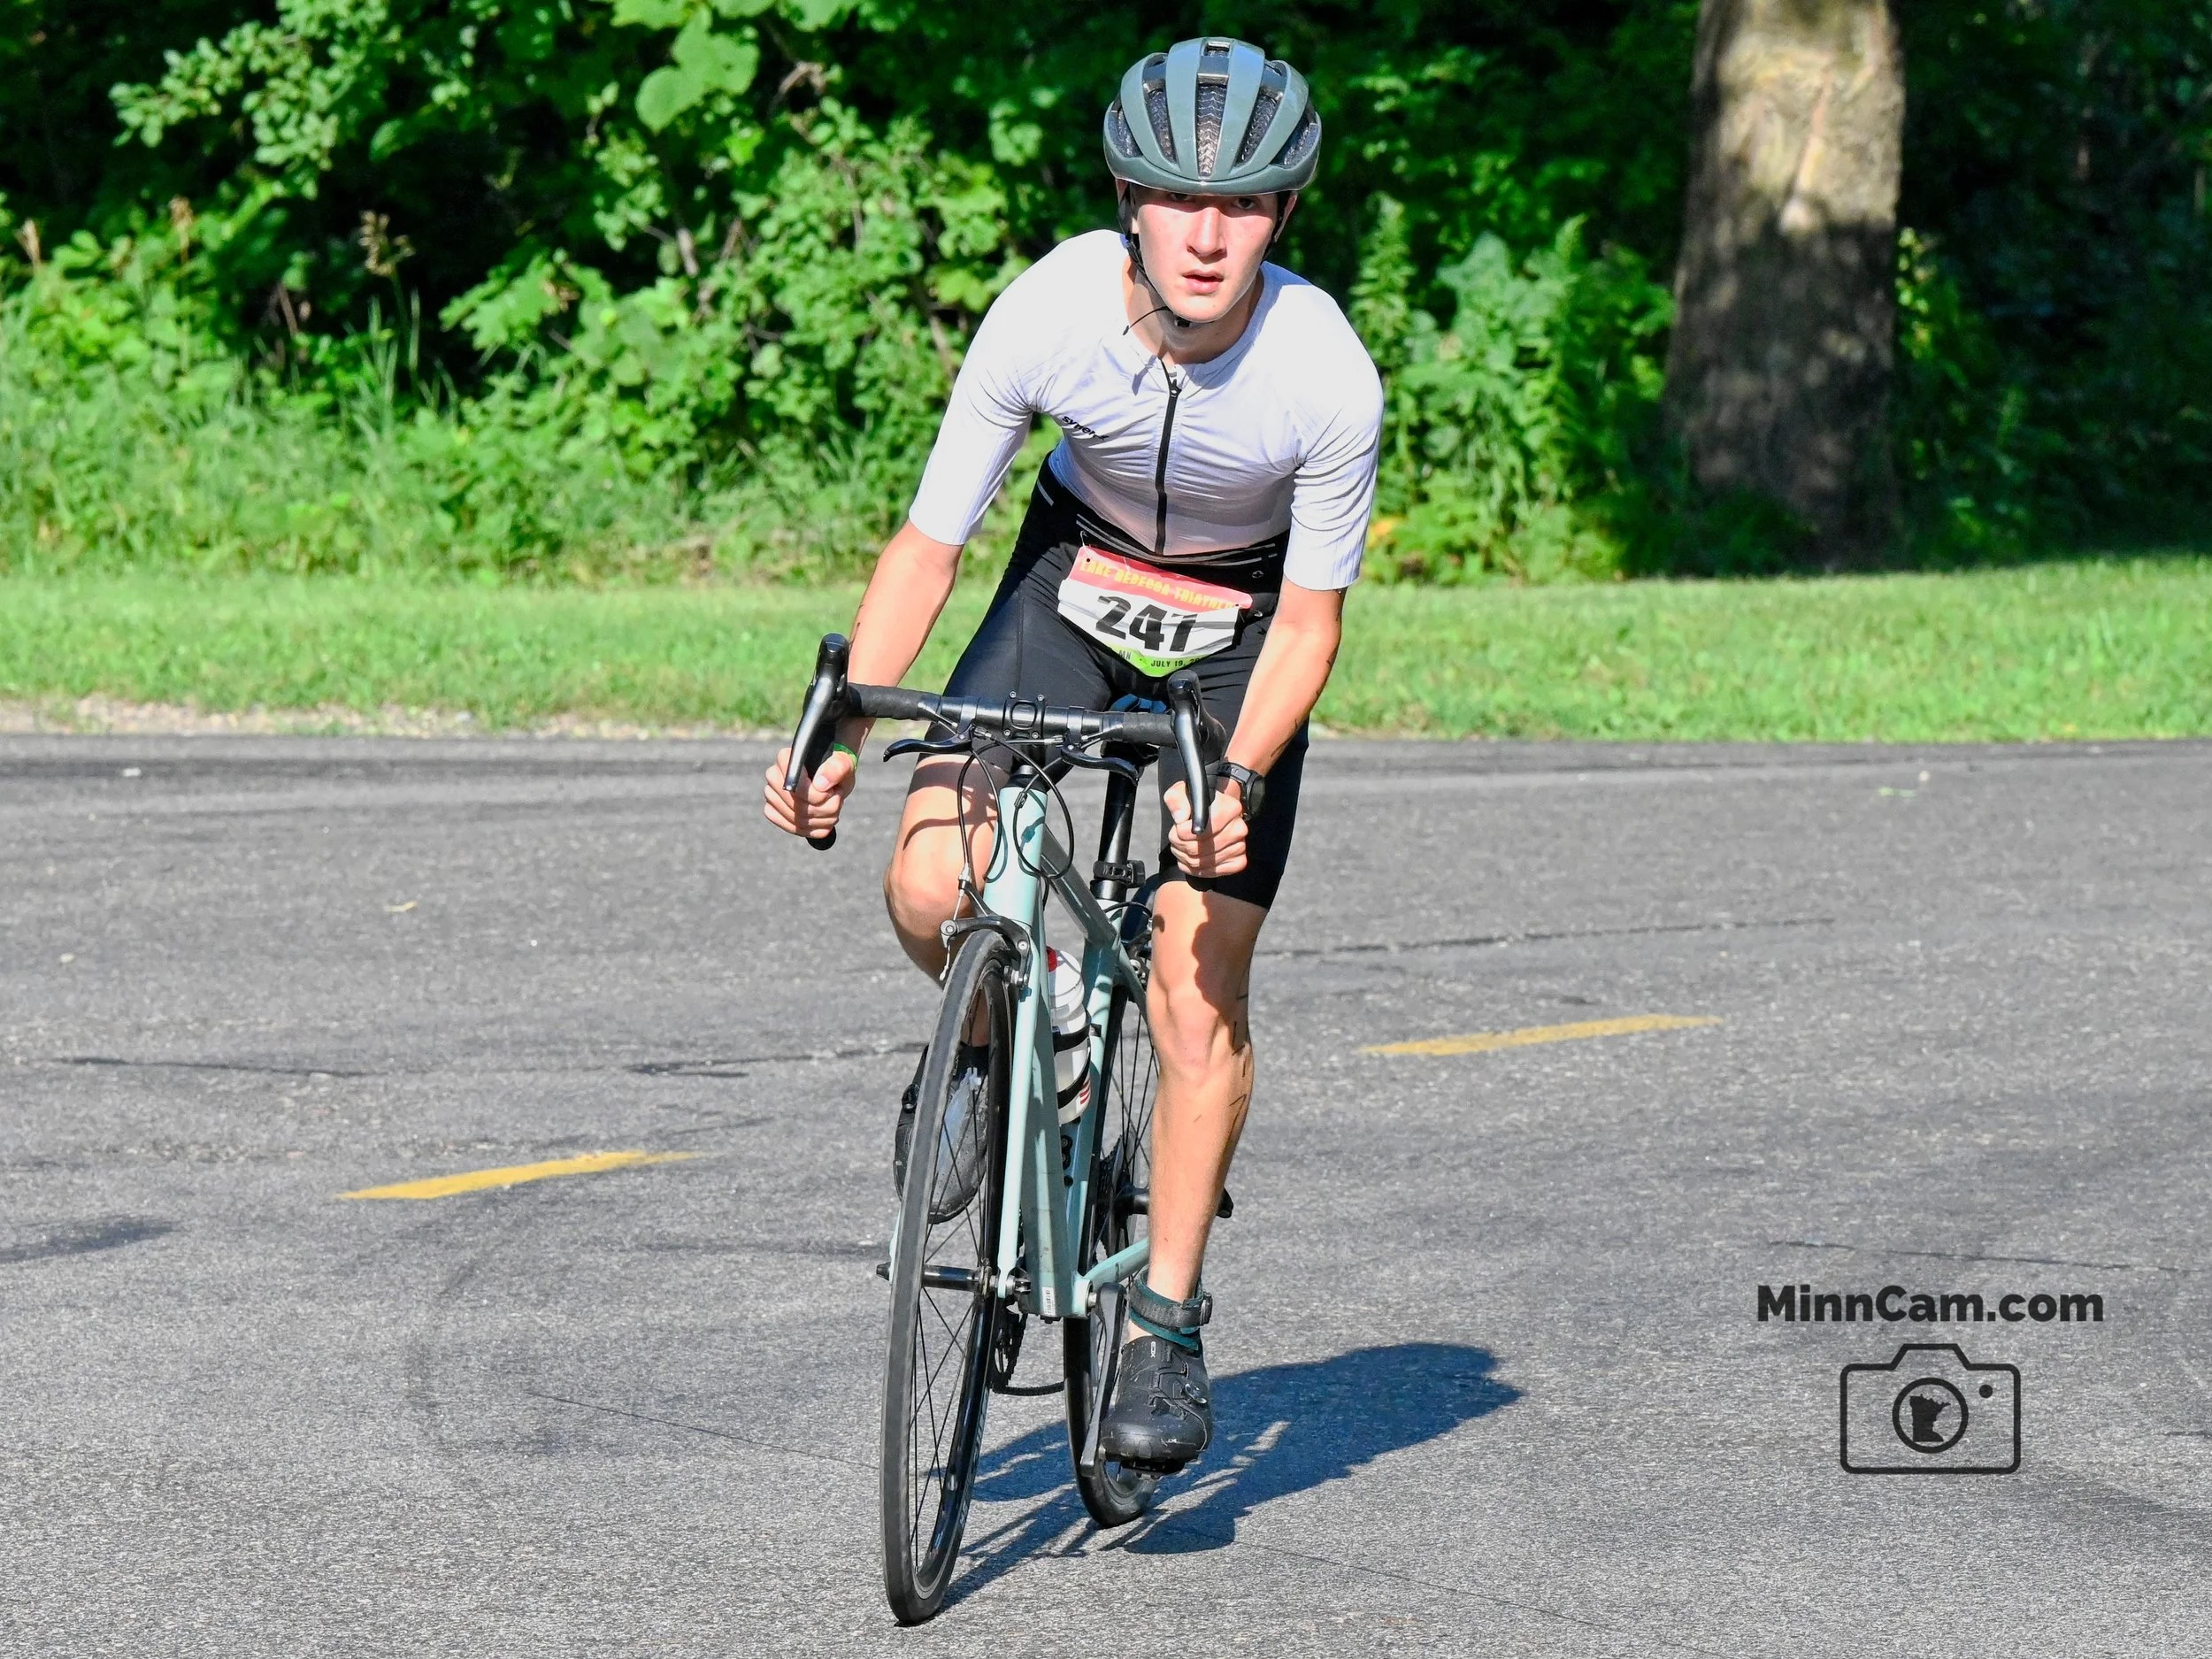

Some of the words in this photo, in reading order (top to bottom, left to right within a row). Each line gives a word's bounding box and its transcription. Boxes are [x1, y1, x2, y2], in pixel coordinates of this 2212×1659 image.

[1079, 558, 1112, 579] LAKE
[1174, 588, 1238, 609] TRIATHL
[1095, 595, 1198, 652] 247
